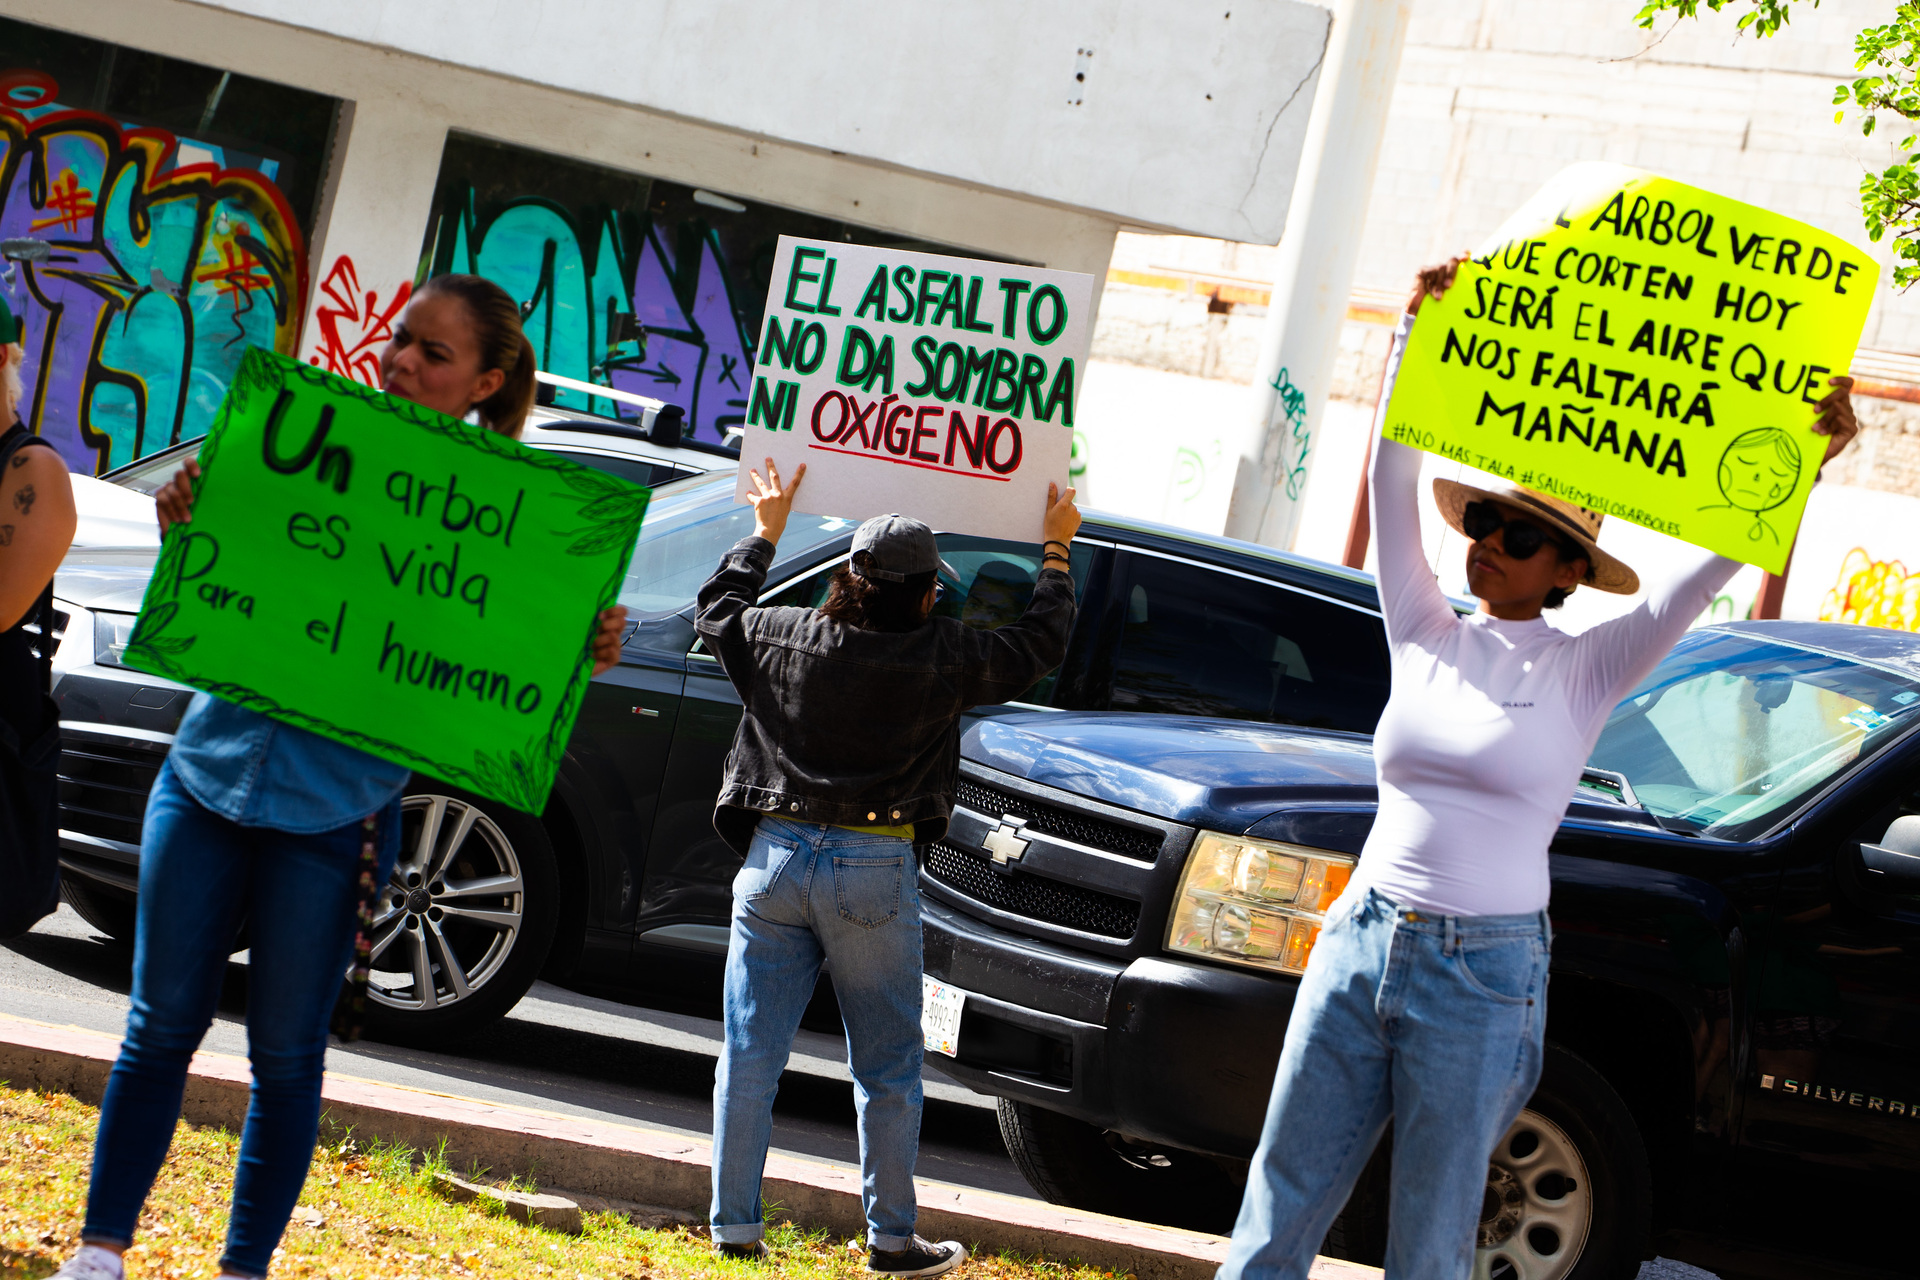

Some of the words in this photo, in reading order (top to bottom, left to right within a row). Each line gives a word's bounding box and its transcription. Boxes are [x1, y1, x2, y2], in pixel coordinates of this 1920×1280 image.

[784, 246, 841, 317] EL
[854, 264, 1068, 346] ASFALTO
[1555, 246, 1693, 301] CORTEN
[1714, 282, 1802, 331] HOY
[1730, 225, 1859, 295] VERDE
[759, 315, 827, 376] NO
[836, 325, 895, 395] DA
[904, 335, 1074, 427] SOMBRA
[1441, 327, 1521, 380] NOS
[1530, 351, 1721, 428] FALTARÁ
[1464, 276, 1559, 330] SERÁ
[1574, 303, 1615, 346] EL
[1629, 319, 1723, 371] AIRE
[1730, 343, 1831, 404] QUE
[262, 388, 354, 494] Un
[385, 470, 525, 548] arbol
[747, 376, 800, 431] NI
[811, 390, 1023, 475] OXÍGENO
[1392, 422, 1435, 448] #NO
[1440, 440, 1470, 464] MAS
[1476, 454, 1515, 478] TALA
[1475, 391, 1687, 478] MAÑANA
[287, 511, 351, 560] es
[173, 532, 256, 619] Para
[305, 600, 347, 654] el
[378, 621, 542, 714] humano
